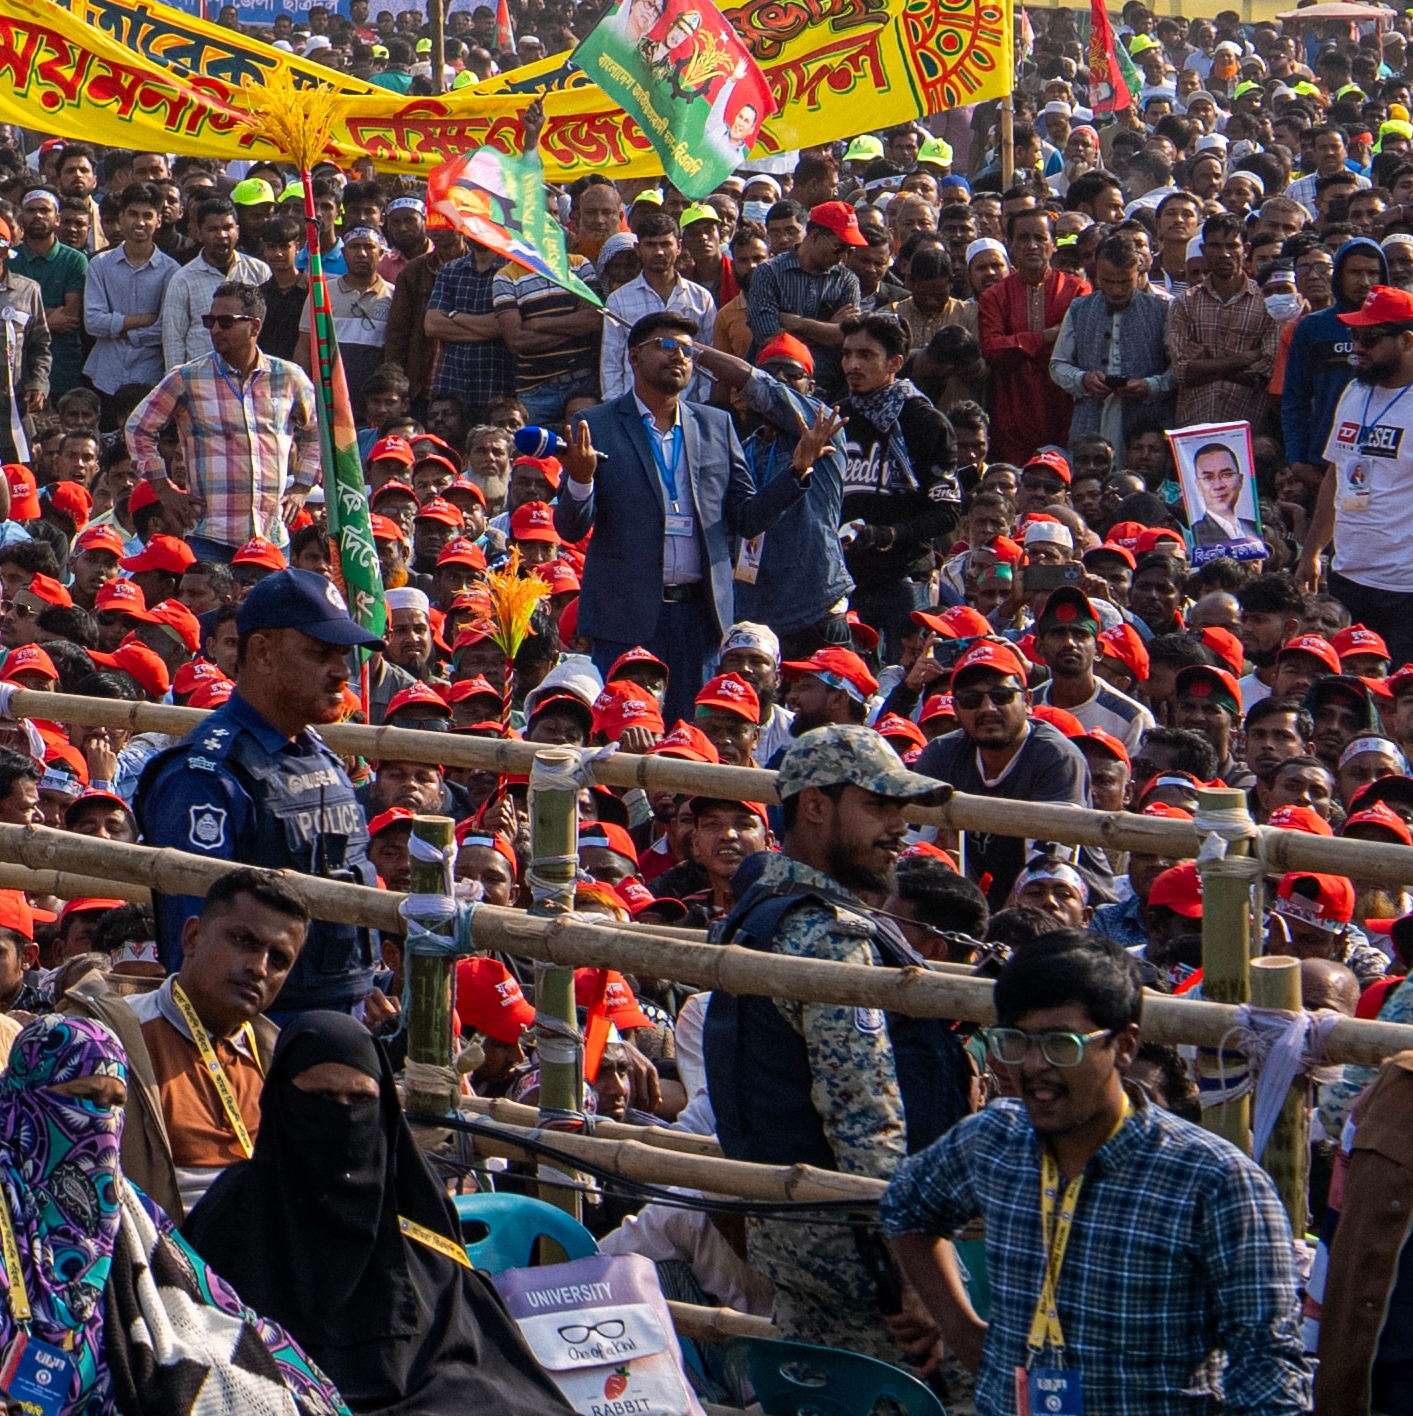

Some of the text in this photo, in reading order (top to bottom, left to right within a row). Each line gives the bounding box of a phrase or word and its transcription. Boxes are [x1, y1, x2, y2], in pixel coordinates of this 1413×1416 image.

[598, 52, 636, 92] বাংলাদেশ
[631, 82, 671, 137] জাতীয়তাবাদী
[297, 804, 361, 842] POLICE
[526, 1282, 613, 1308] UNIVERSITY
[568, 1346, 590, 1361] One
